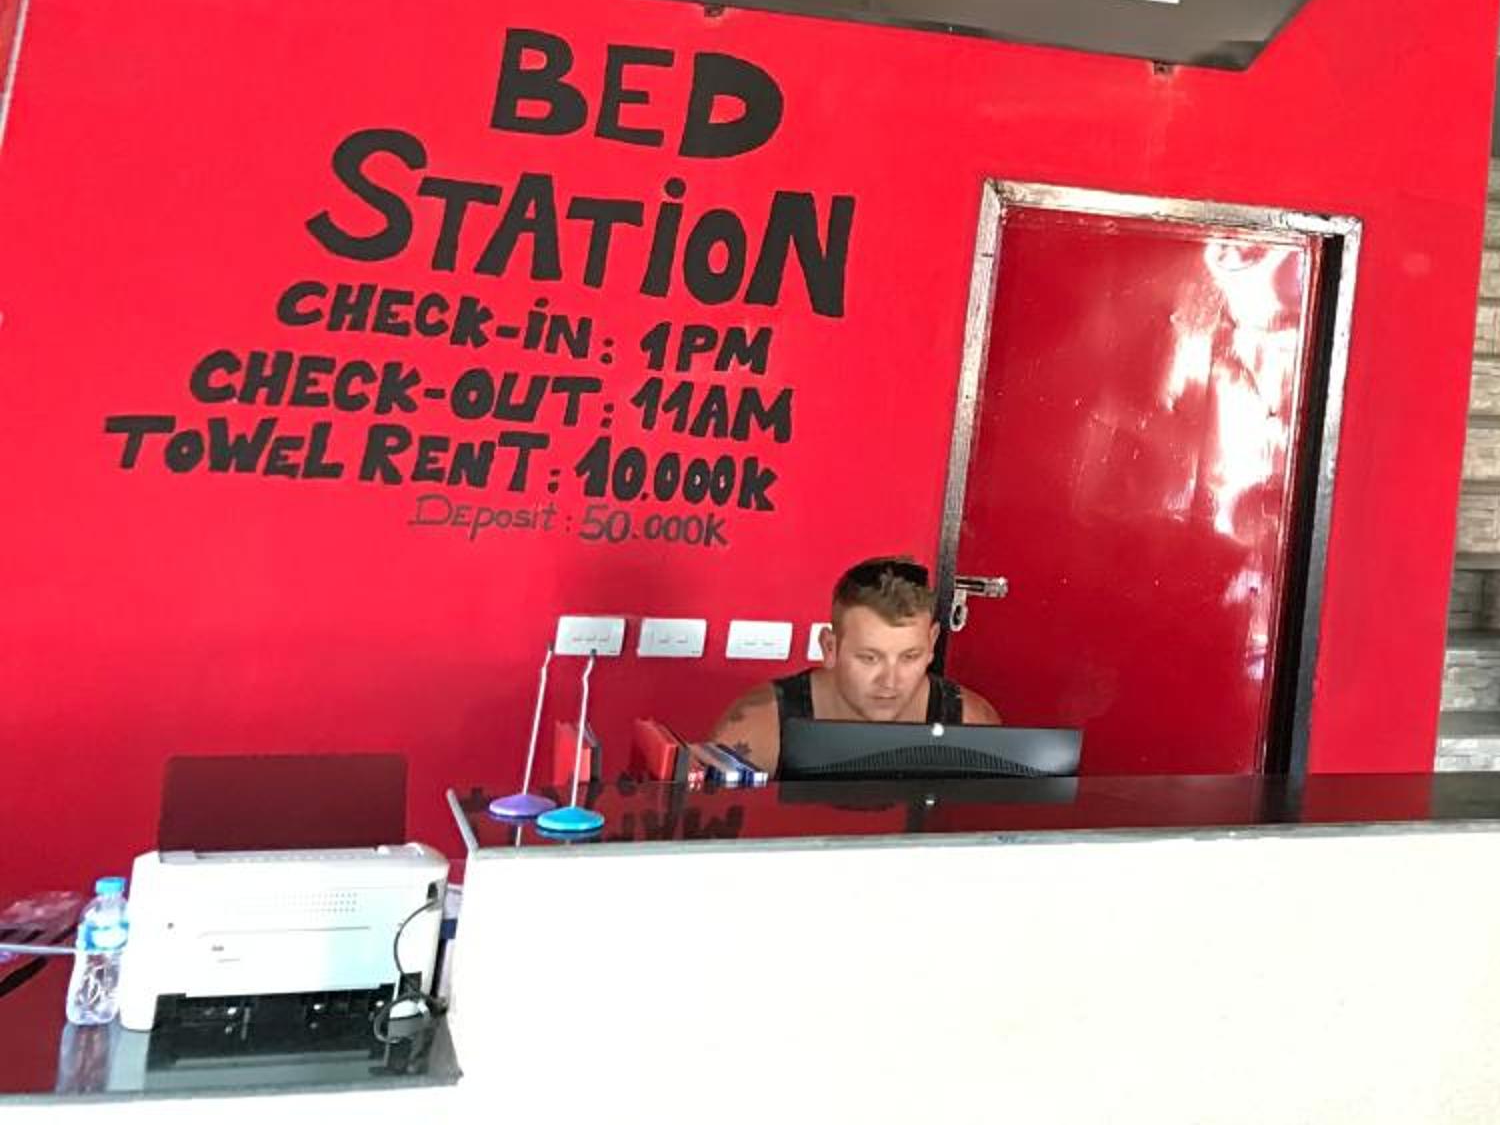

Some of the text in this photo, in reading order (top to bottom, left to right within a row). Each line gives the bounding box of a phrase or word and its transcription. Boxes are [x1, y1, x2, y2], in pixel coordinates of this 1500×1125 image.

[490, 27, 785, 159] BED
[639, 321, 772, 375] 1PM
[631, 377, 793, 443] 11AM
[104, 414, 344, 476] TOWEL
